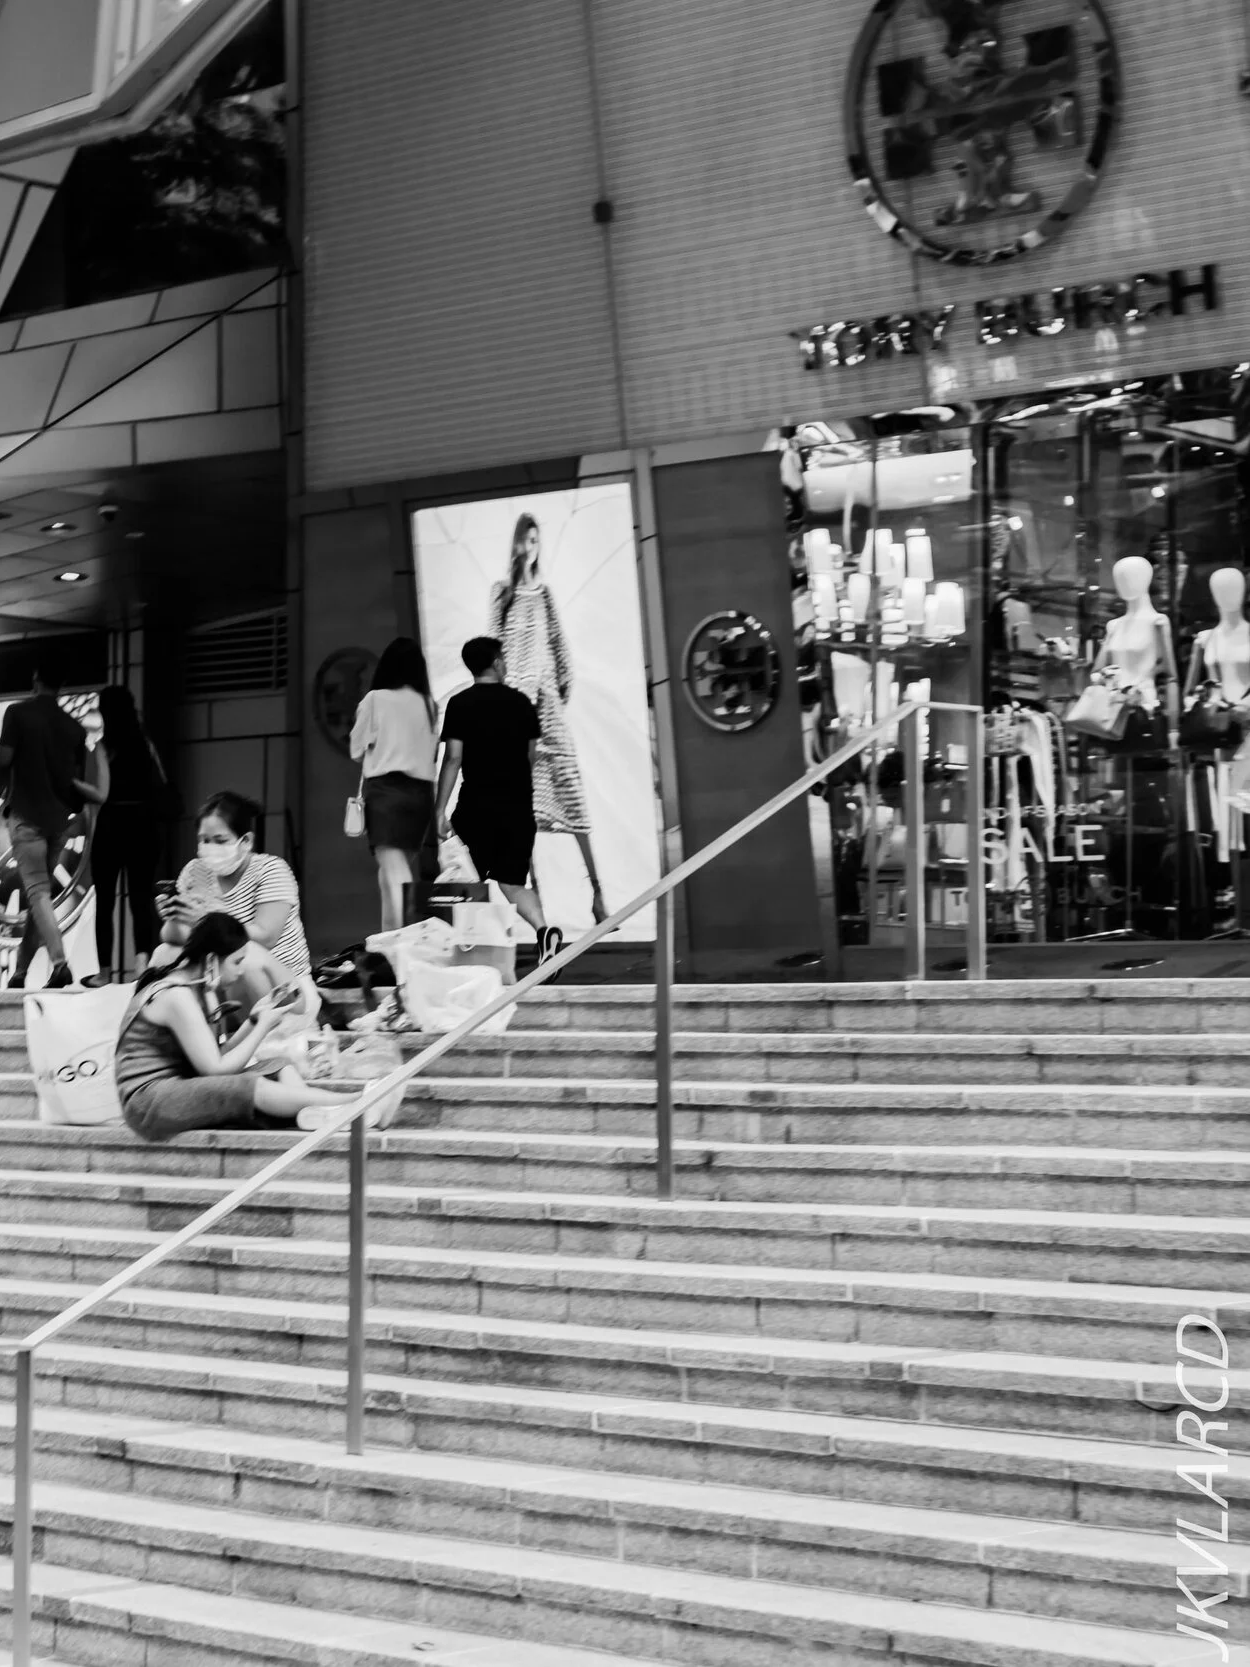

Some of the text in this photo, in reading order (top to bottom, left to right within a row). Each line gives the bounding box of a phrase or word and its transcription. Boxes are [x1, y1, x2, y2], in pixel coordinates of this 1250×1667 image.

[790, 263, 1220, 370] TORY BURCH
[980, 824, 1106, 865] SALE
